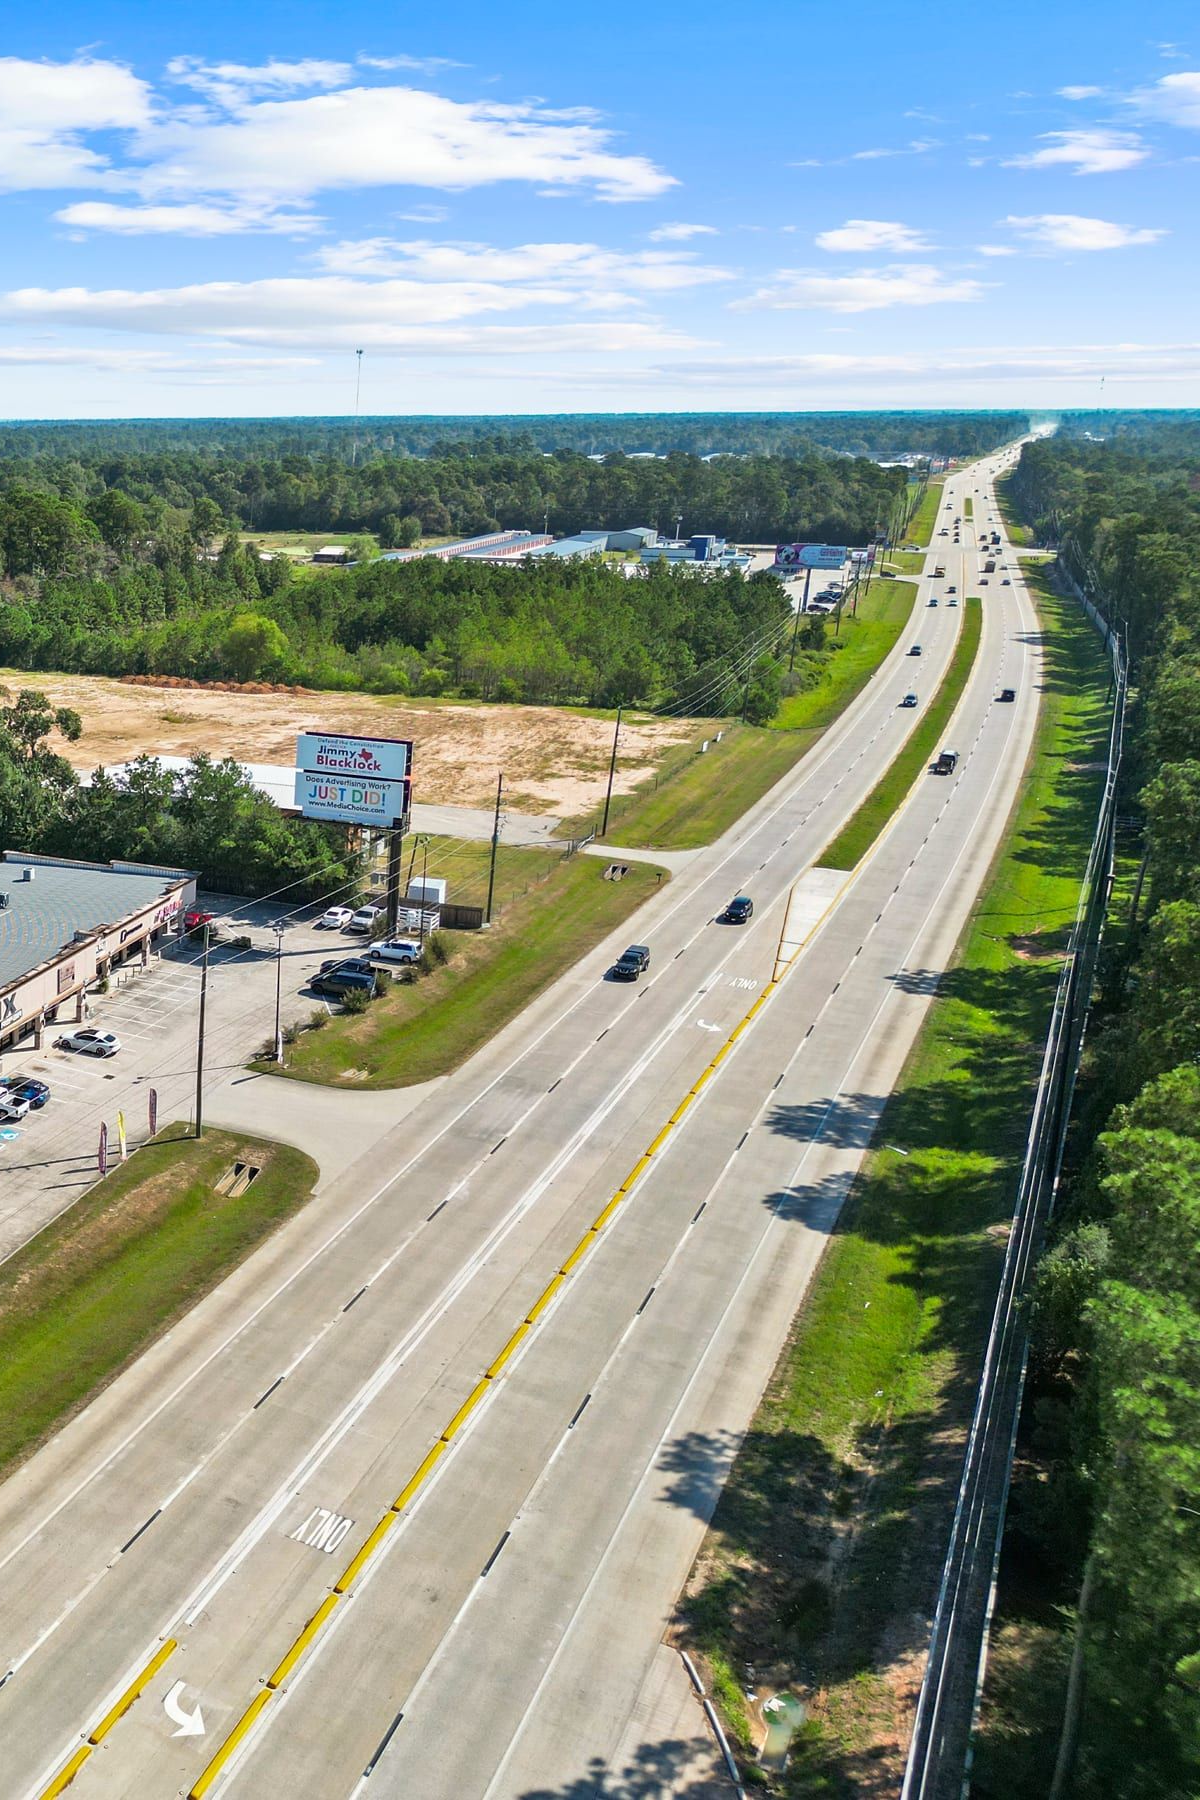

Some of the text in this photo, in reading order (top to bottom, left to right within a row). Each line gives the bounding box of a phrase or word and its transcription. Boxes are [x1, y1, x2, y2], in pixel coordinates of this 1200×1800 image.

[318, 745, 357, 758] Jimmy
[317, 755, 381, 771] Blacklock
[305, 775, 391, 791] Does Advertising Work?
[308, 786, 386, 807] JUST DID!
[308, 800, 385, 814] www.MediaChoice.com
[729, 977, 758, 990] ONLY
[288, 1507, 355, 1553] ONLY
